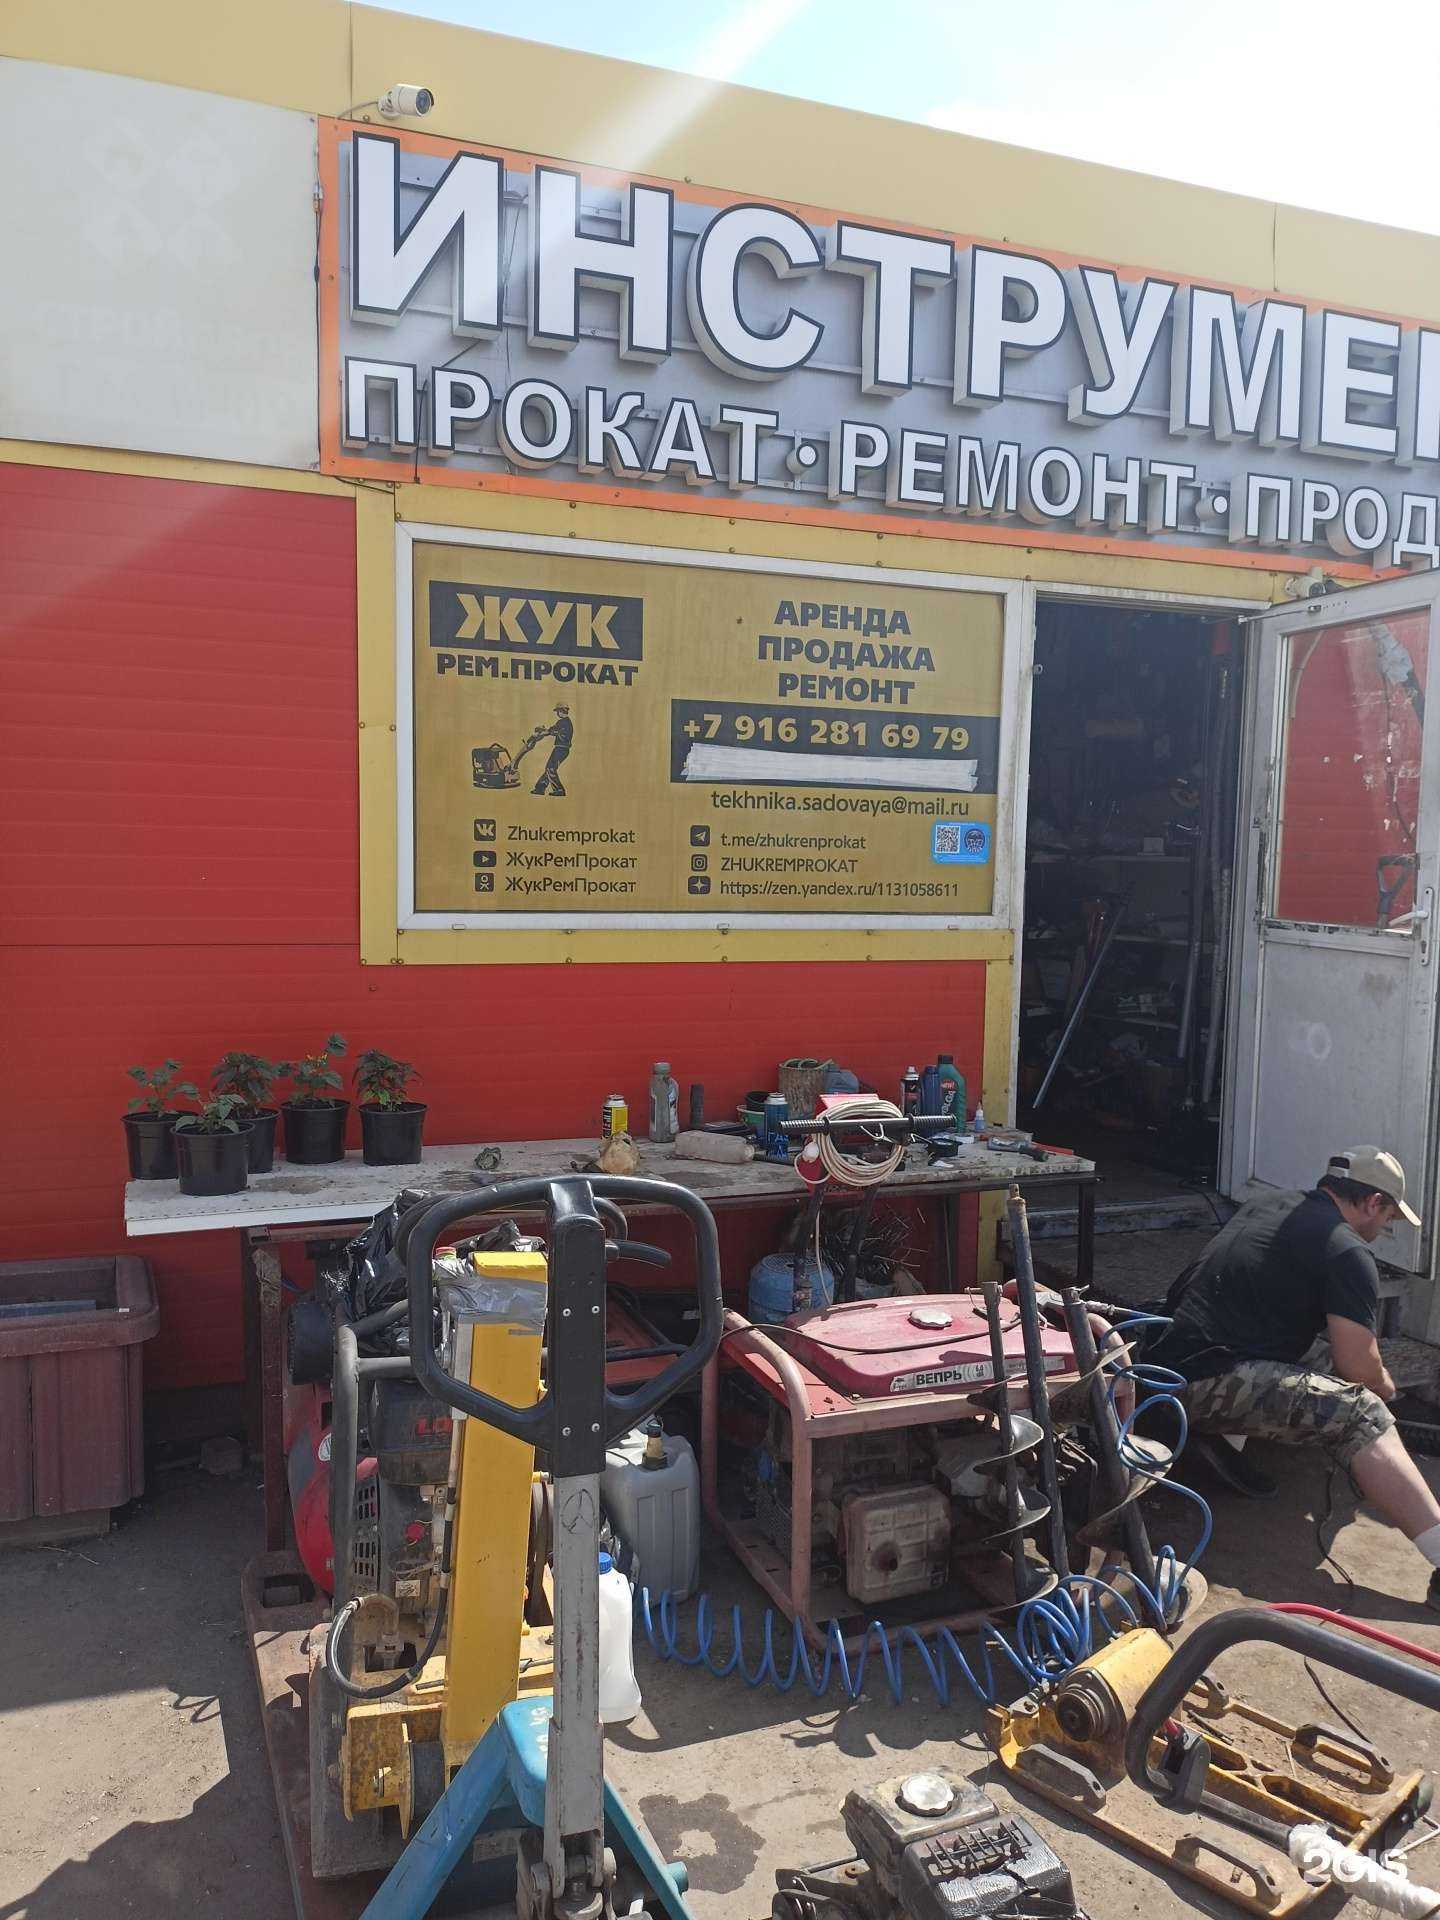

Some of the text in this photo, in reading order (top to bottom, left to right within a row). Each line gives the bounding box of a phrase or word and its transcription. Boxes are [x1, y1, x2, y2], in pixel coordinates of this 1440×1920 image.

[344, 355, 1440, 569] ПРОКАТ РЕМОНТ ПРОД
[455, 592, 621, 650] ЖУК
[774, 600, 911, 638] АРЕНДА
[758, 635, 936, 672] ПРОДАЖА
[436, 653, 639, 687] РЕМ.ПРОКАТ
[778, 672, 915, 705] РЕМОНТ
[683, 714, 970, 751] +7 916 281 69 79
[711, 790, 970, 817] tekhnika.sadovaya@mail.ru
[507, 824, 636, 845] Zhukremprokat
[505, 850, 638, 871] ЖукРемПрокат
[720, 857, 859, 874] ZHUKREMPROKAT
[504, 876, 637, 895] ЖукРемПрокат
[720, 879, 959, 898] https://zen.yandex.ru/1131058611
[916, 1370, 962, 1386] ВЕПРЬ
